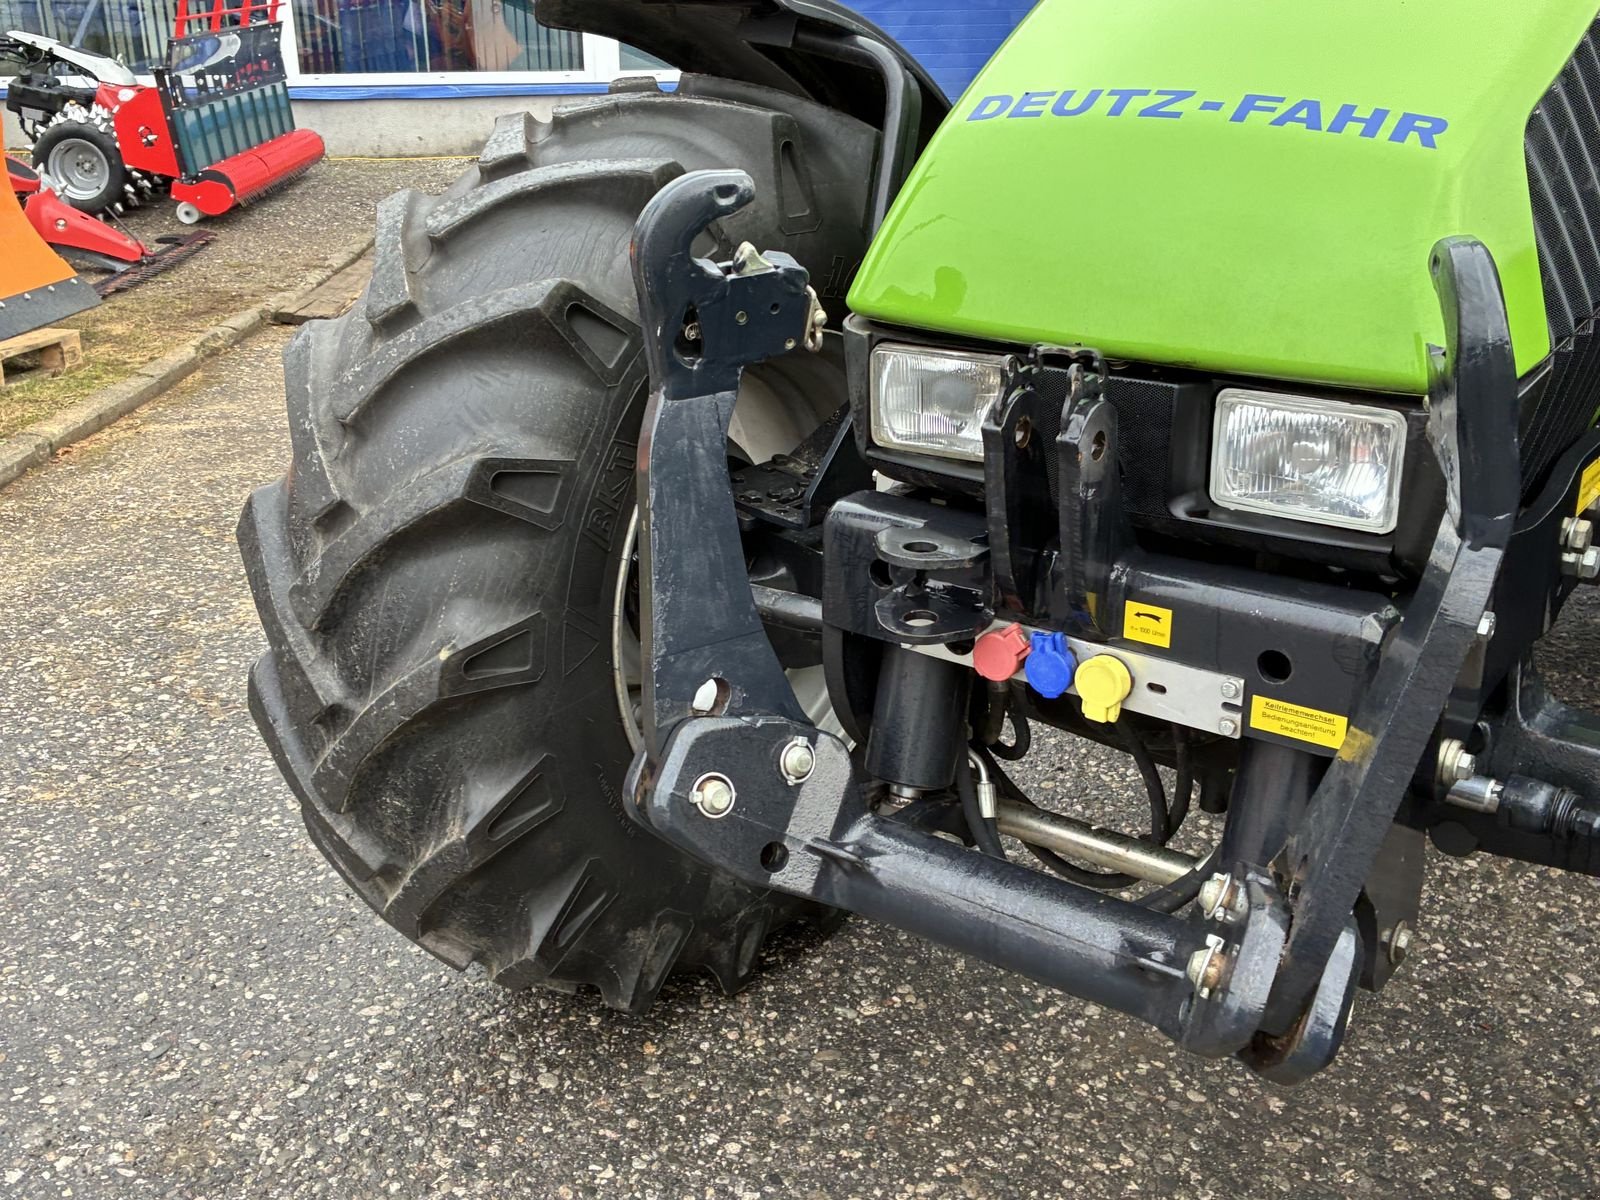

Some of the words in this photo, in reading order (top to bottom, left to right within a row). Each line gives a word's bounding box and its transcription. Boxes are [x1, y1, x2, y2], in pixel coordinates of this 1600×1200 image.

[966, 89, 1448, 148] DEUTZ-FAHR
[587, 445, 636, 545] BKT
[1261, 711, 1336, 736] Bedienungsanleitung
[1265, 701, 1335, 724] Keilriemenwechsel
[1280, 724, 1316, 738] beachten!
